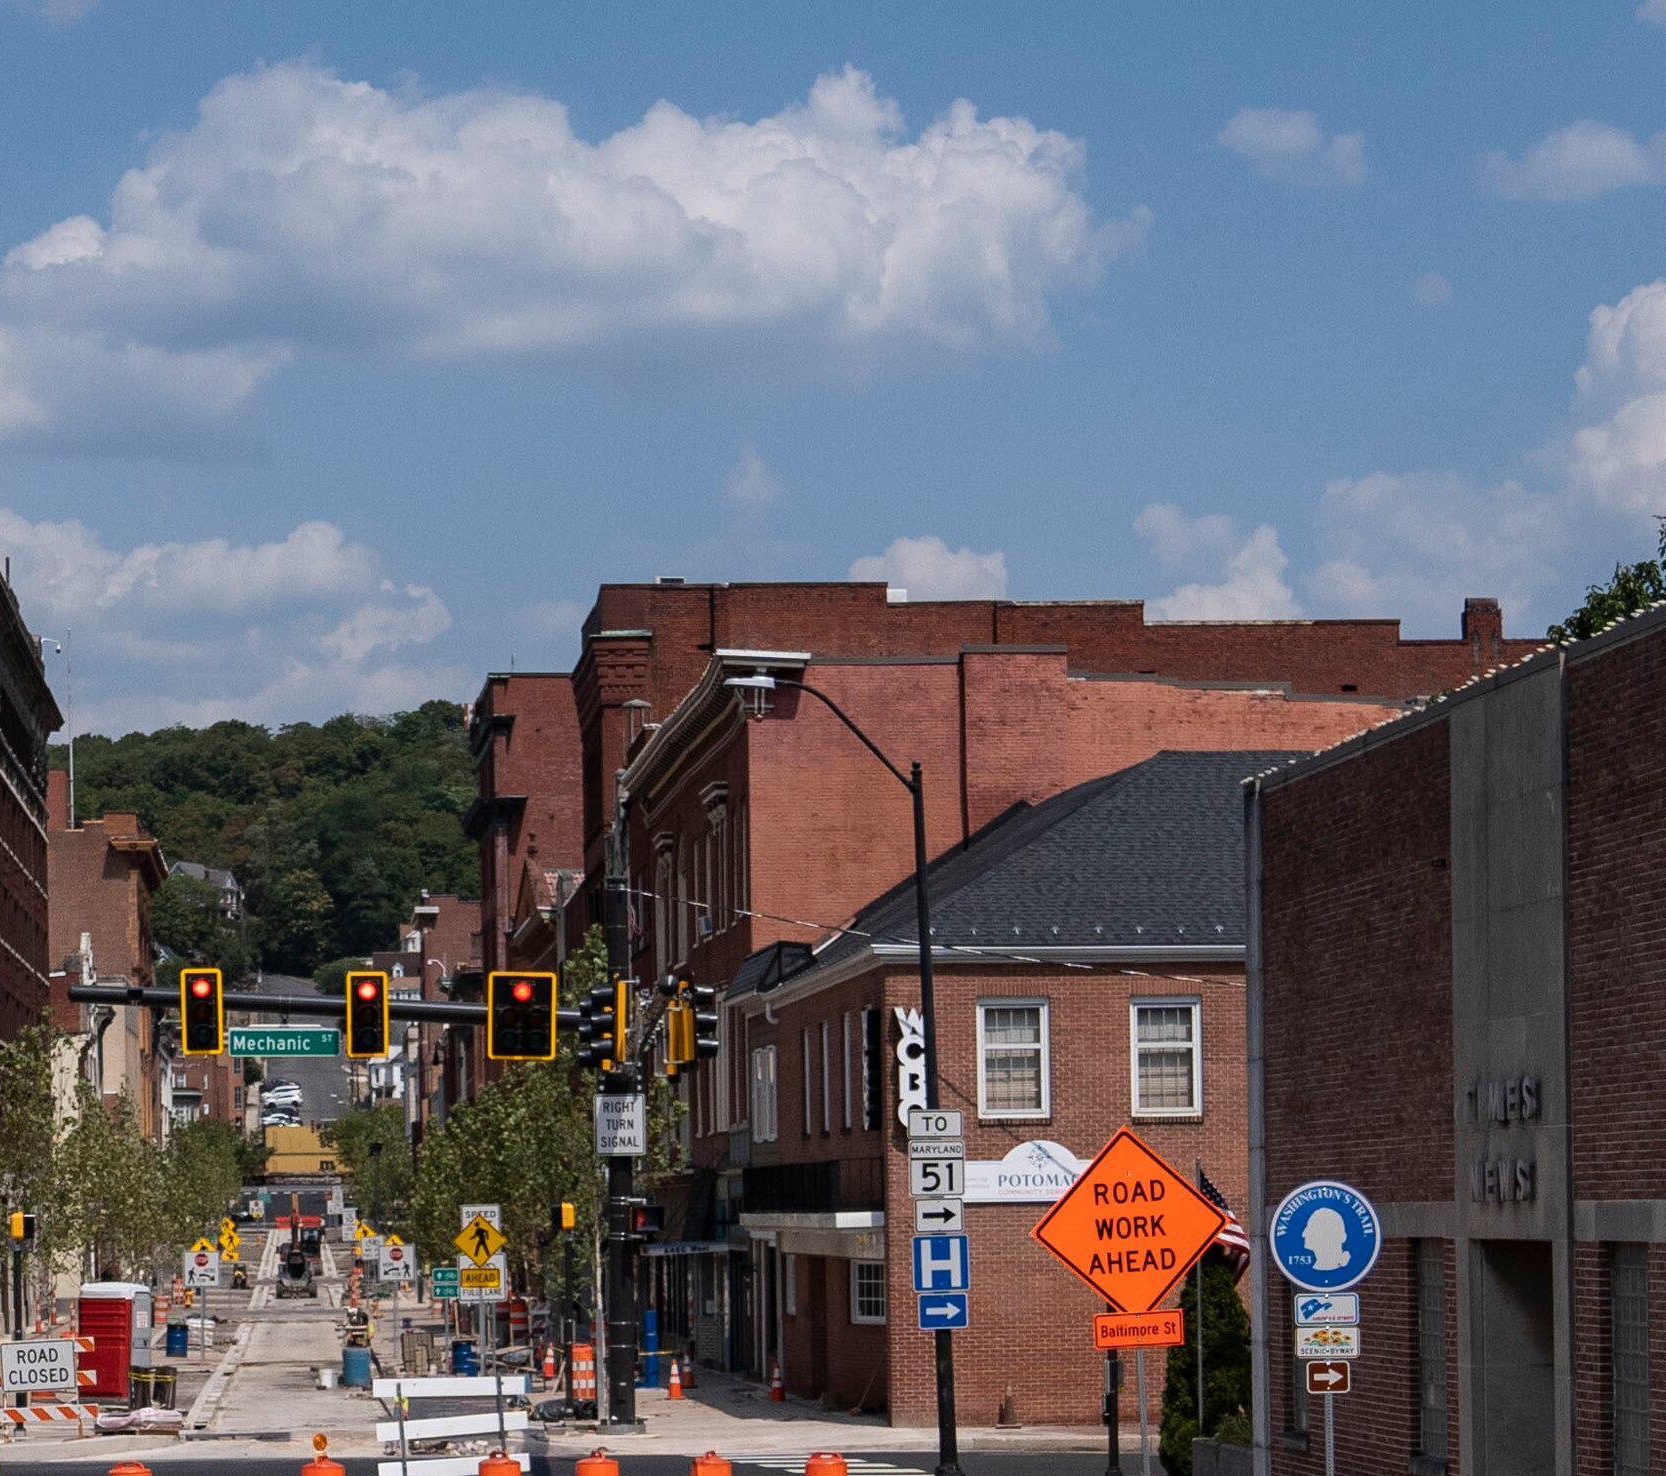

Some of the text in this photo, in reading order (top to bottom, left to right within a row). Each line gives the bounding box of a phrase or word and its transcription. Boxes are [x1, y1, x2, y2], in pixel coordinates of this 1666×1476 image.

[233, 1034, 333, 1051] Mechanic ST
[603, 1102, 635, 1113] RIGHT
[606, 1119, 634, 1130] TURN
[921, 1116, 947, 1132] TO
[600, 1136, 639, 1148] SIGNAL
[911, 1145, 962, 1154] MARYLAND
[922, 1162, 954, 1192] 51
[1094, 1179, 1165, 1206] ROAD
[1276, 1188, 1374, 1237] WASHINGTON'S TRAIL
[1095, 1214, 1166, 1240] WORK
[920, 1239, 962, 1288] H
[1089, 1248, 1176, 1275] AHEAD
[1288, 1255, 1312, 1265] 1753
[466, 1274, 495, 1283] AHEAD
[1101, 1321, 1176, 1339] Baltimore St
[17, 1348, 58, 1364] ROAD
[8, 1368, 69, 1385] CLOSED
